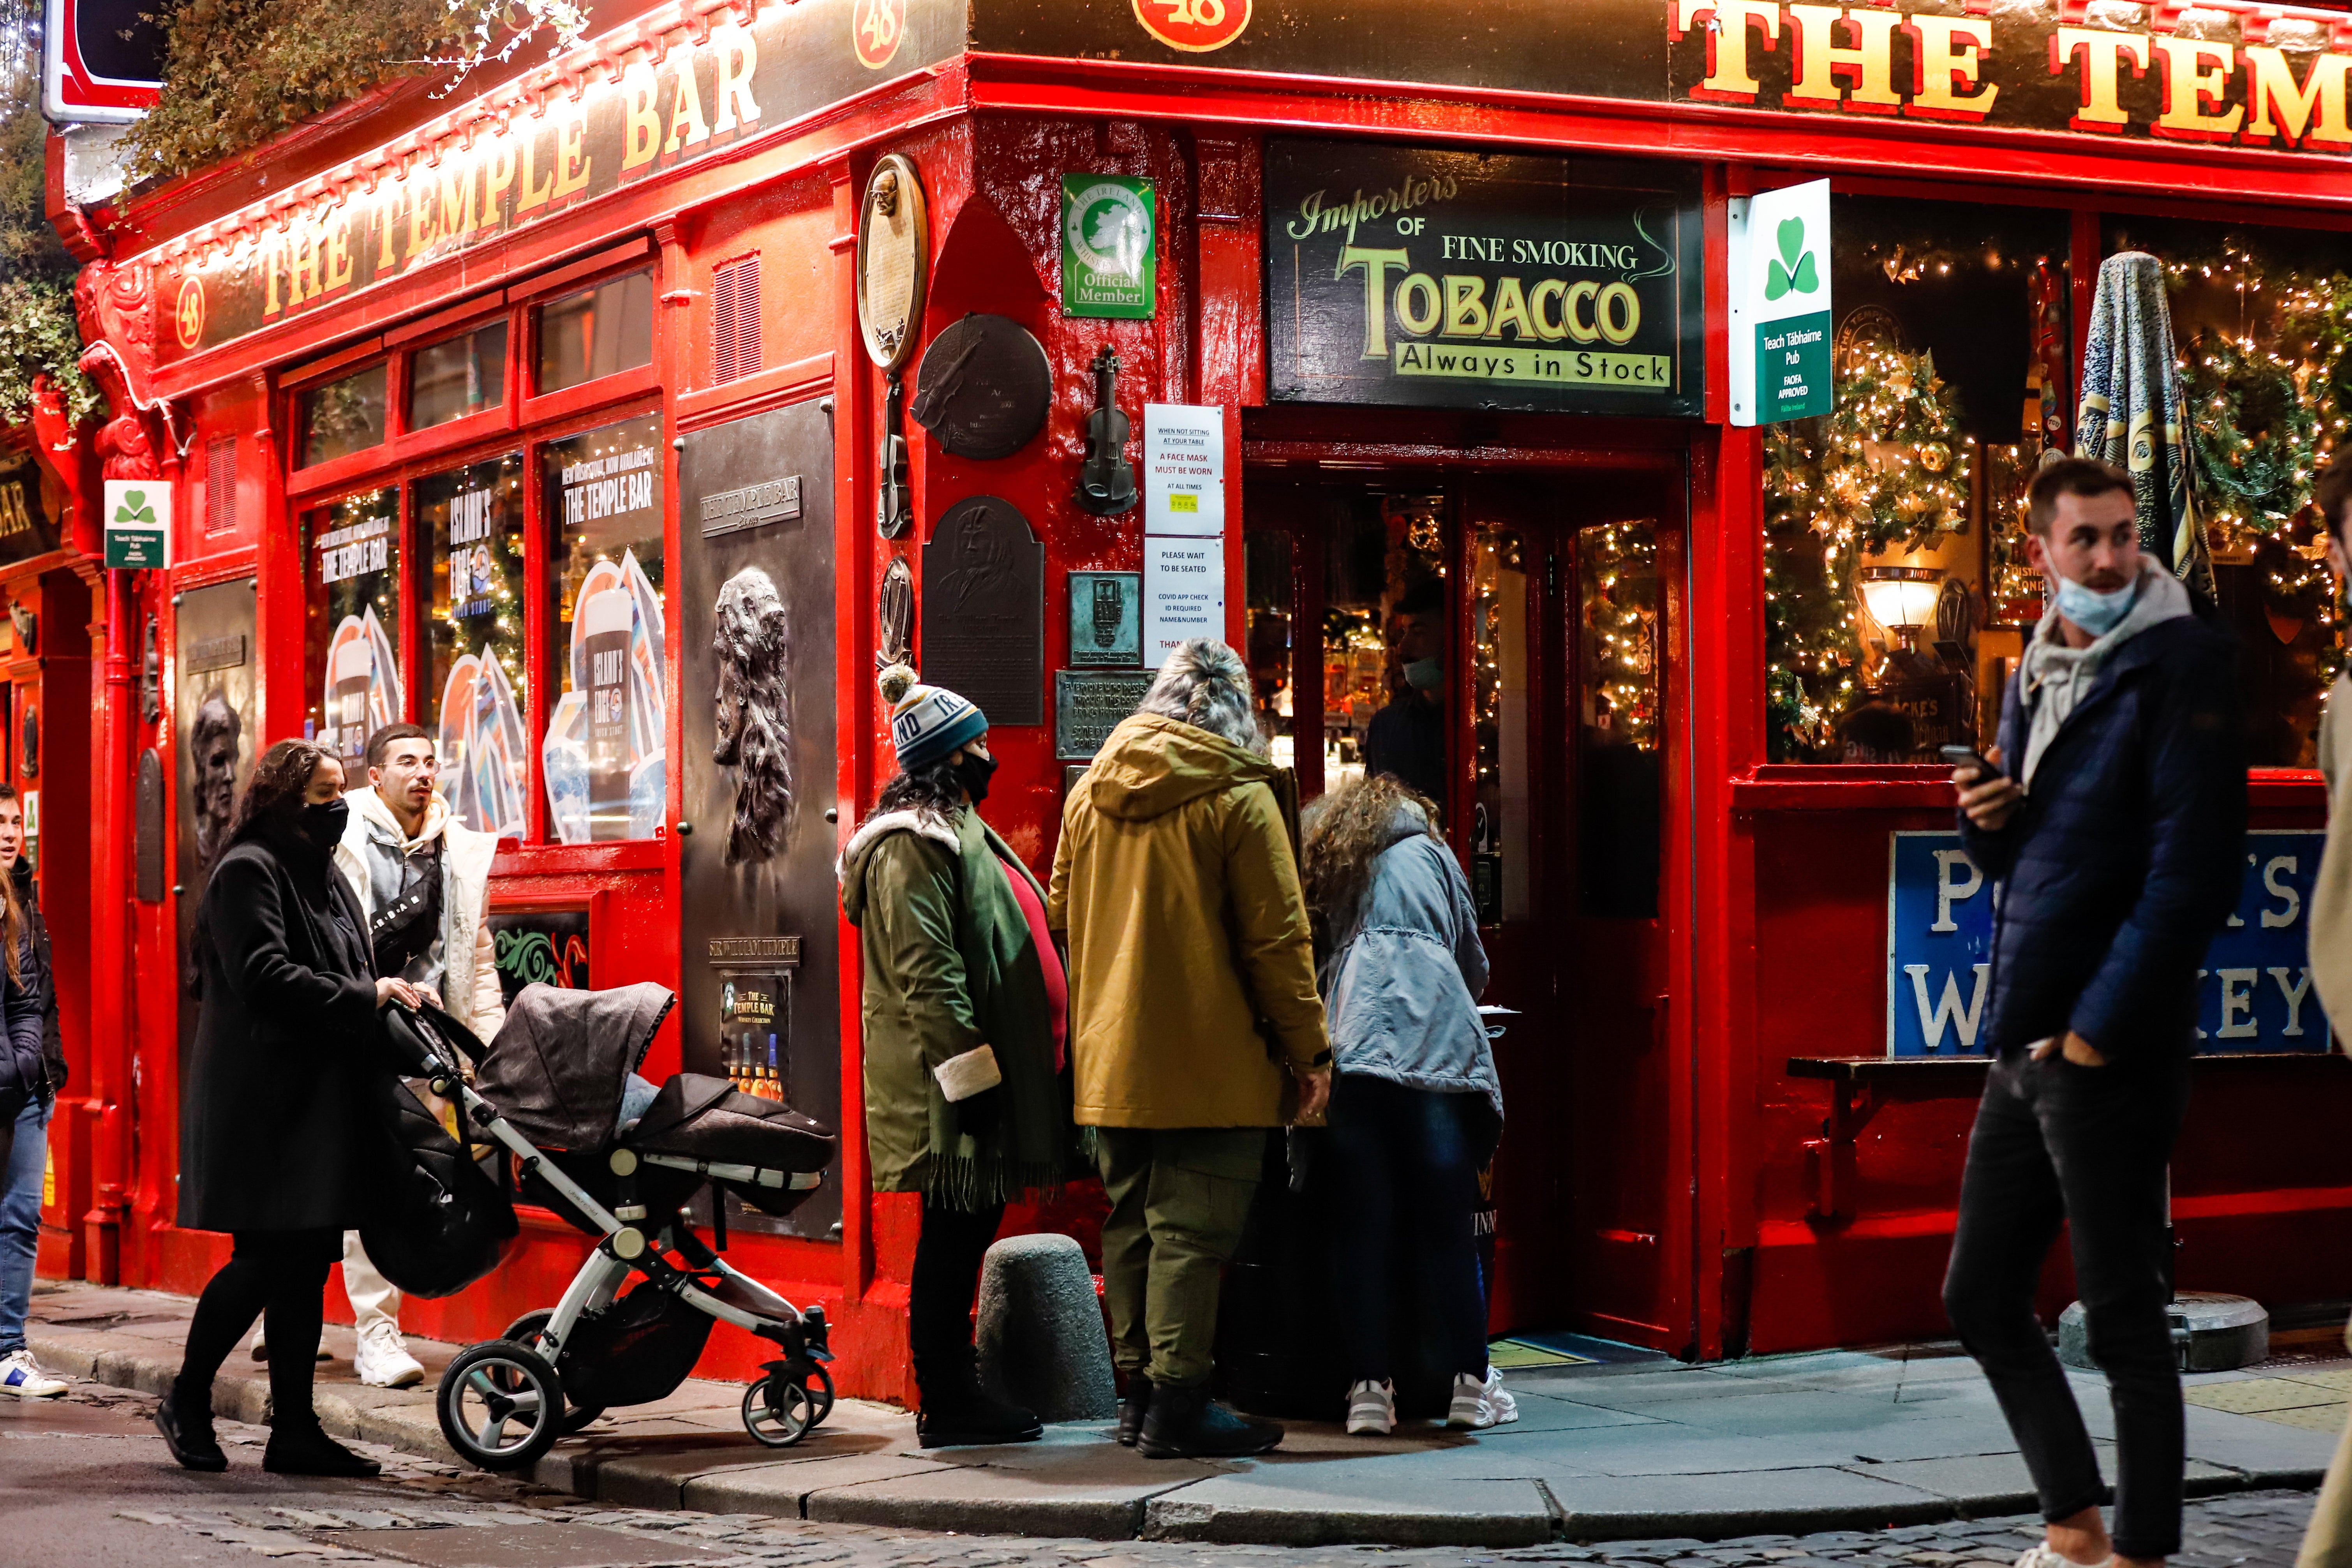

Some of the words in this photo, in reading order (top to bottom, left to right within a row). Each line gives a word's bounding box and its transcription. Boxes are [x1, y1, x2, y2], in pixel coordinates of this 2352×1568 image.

[1678, 0, 1999, 113] THE
[2058, 27, 2352, 143] TEM
[257, 208, 354, 316] THE
[369, 99, 592, 271] TEMPLE
[621, 29, 761, 172] BAR
[1074, 192, 1094, 212] THE
[1096, 186, 1143, 215] IRELAND
[1286, 172, 1458, 244] Importers
[1396, 217, 1426, 236] OF
[1076, 240, 1114, 270] WHISKEY
[1441, 235, 1505, 261] FINE
[1511, 238, 1638, 270] SMOKING
[1084, 273, 1137, 287] Official
[1080, 288, 1140, 303] Member
[1335, 244, 1641, 360] TOBACCO
[180, 292, 199, 339] 48
[1763, 334, 1785, 350] Teach
[1786, 329, 1822, 347] Tábhairne
[1401, 344, 1515, 378] Always
[1534, 354, 1560, 377] in
[1576, 351, 1664, 382] Stock
[1786, 350, 1800, 365] Pub
[1778, 386, 1808, 399] APPROVED
[605, 455, 619, 475] NOW
[619, 448, 647, 472] AVAILABLE
[647, 446, 654, 465] AT
[0, 480, 31, 538] AR
[564, 486, 584, 525] THE
[586, 476, 627, 520] TEMPLE
[629, 470, 652, 511] BAR
[701, 497, 723, 521] THE
[726, 485, 772, 516] TEMPLE
[773, 479, 798, 504] BAR
[450, 488, 491, 545] ISLAND'S
[322, 549, 339, 584] THE
[338, 541, 369, 580] TEMPLE
[369, 537, 388, 572] BAR
[594, 649, 623, 687] ISLAND'S
[594, 689, 610, 724] EDGE
[1100, 707, 1135, 717] HAPPINES
[1072, 725, 1093, 735] SOME
[1095, 726, 1106, 734] BY
[1074, 738, 1095, 748] SOME
[709, 941, 722, 956] SIR
[723, 940, 761, 956] WILLIAM
[762, 939, 798, 956] TEMPLE
[734, 1002, 759, 1014] TEMPLE
[748, 991, 759, 1001] THE
